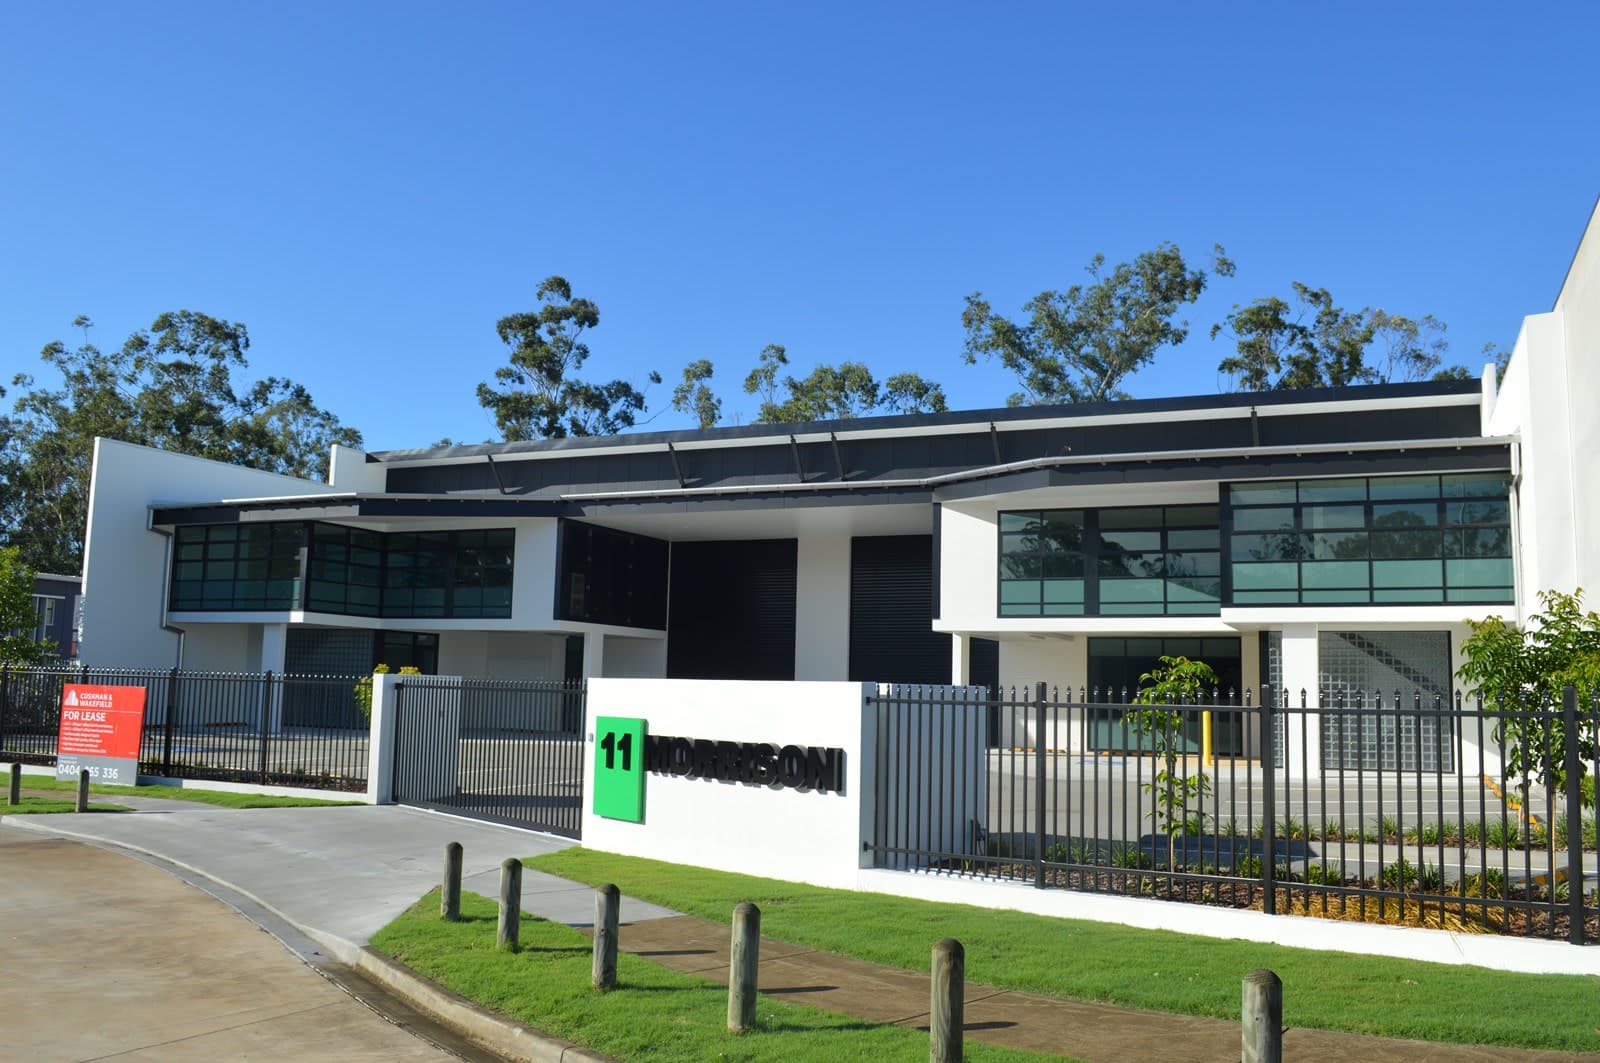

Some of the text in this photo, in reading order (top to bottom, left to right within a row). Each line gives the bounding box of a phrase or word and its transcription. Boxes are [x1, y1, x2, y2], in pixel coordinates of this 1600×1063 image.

[80, 700, 112, 708] WAKEFIELD
[63, 711, 107, 722] FOR LEASE
[600, 732, 845, 792] 11 MORRISON
[58, 764, 80, 775] 0404
[102, 767, 118, 779] 336
